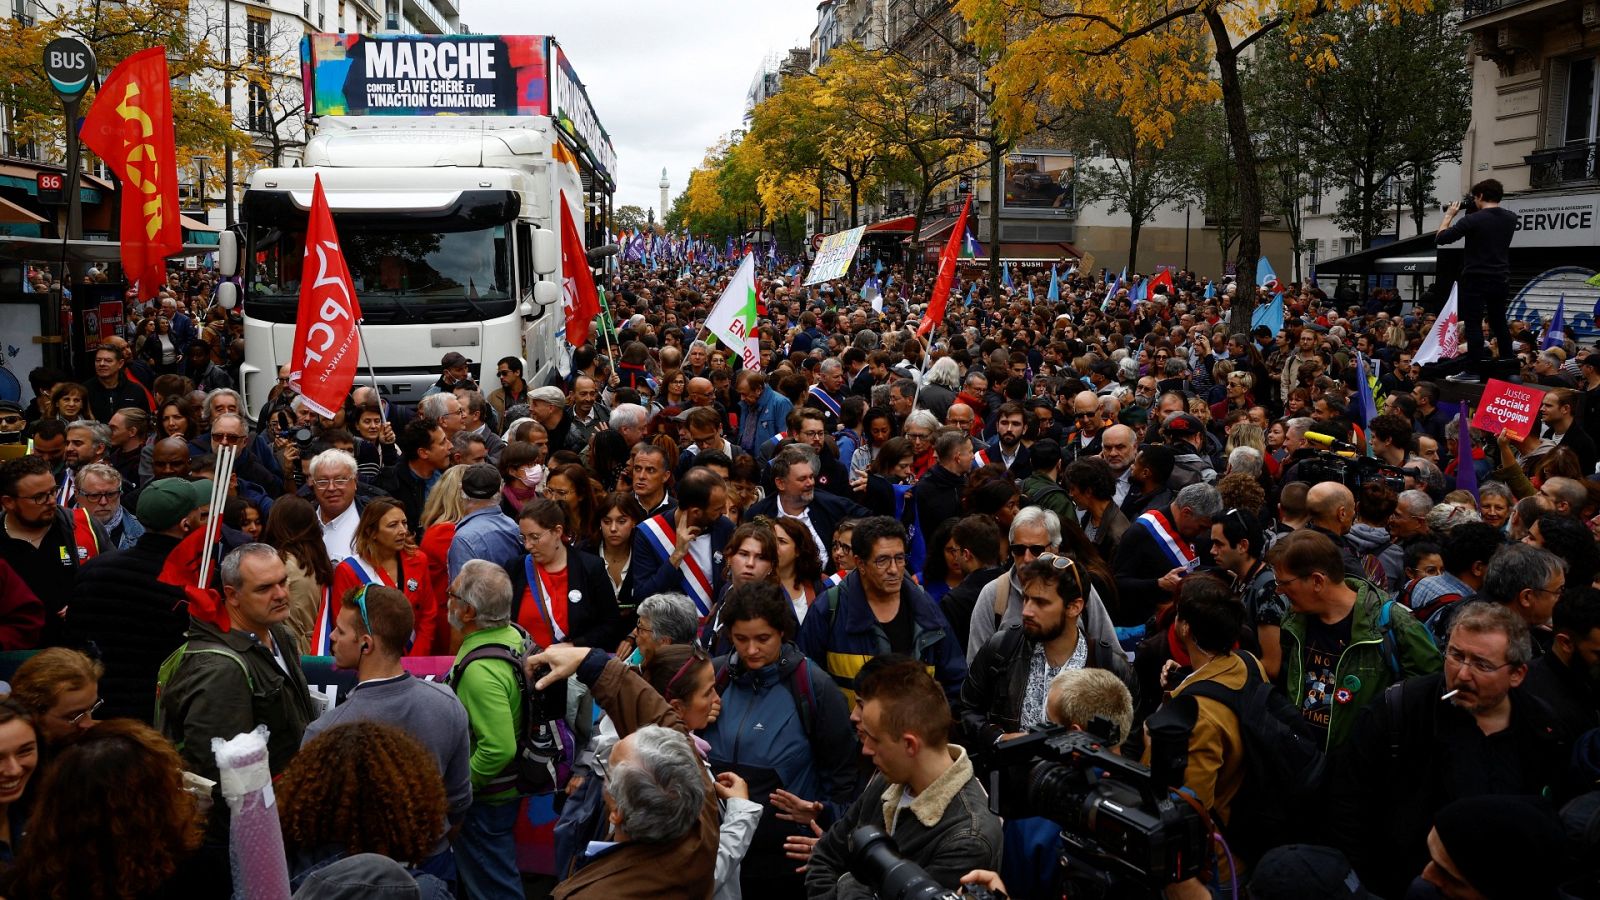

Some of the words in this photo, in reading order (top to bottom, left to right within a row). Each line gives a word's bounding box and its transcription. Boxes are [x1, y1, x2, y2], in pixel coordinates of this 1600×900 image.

[50, 51, 85, 70] BUS
[365, 42, 496, 79] MARCHE
[366, 83, 396, 93] CONTRE
[397, 80, 411, 93] LA
[412, 80, 429, 93] VIE
[430, 77, 465, 93] CHÈRE
[466, 84, 475, 93] ET
[367, 93, 427, 107] L'INACTION
[430, 94, 496, 107] CLIMATIQUE
[41, 176, 59, 189] 86
[1514, 211, 1592, 231] SERVICE
[1494, 397, 1524, 411] sociale
[1524, 404, 1530, 413] &
[1486, 403, 1529, 424] écologique
[1314, 655, 1331, 667] NO
